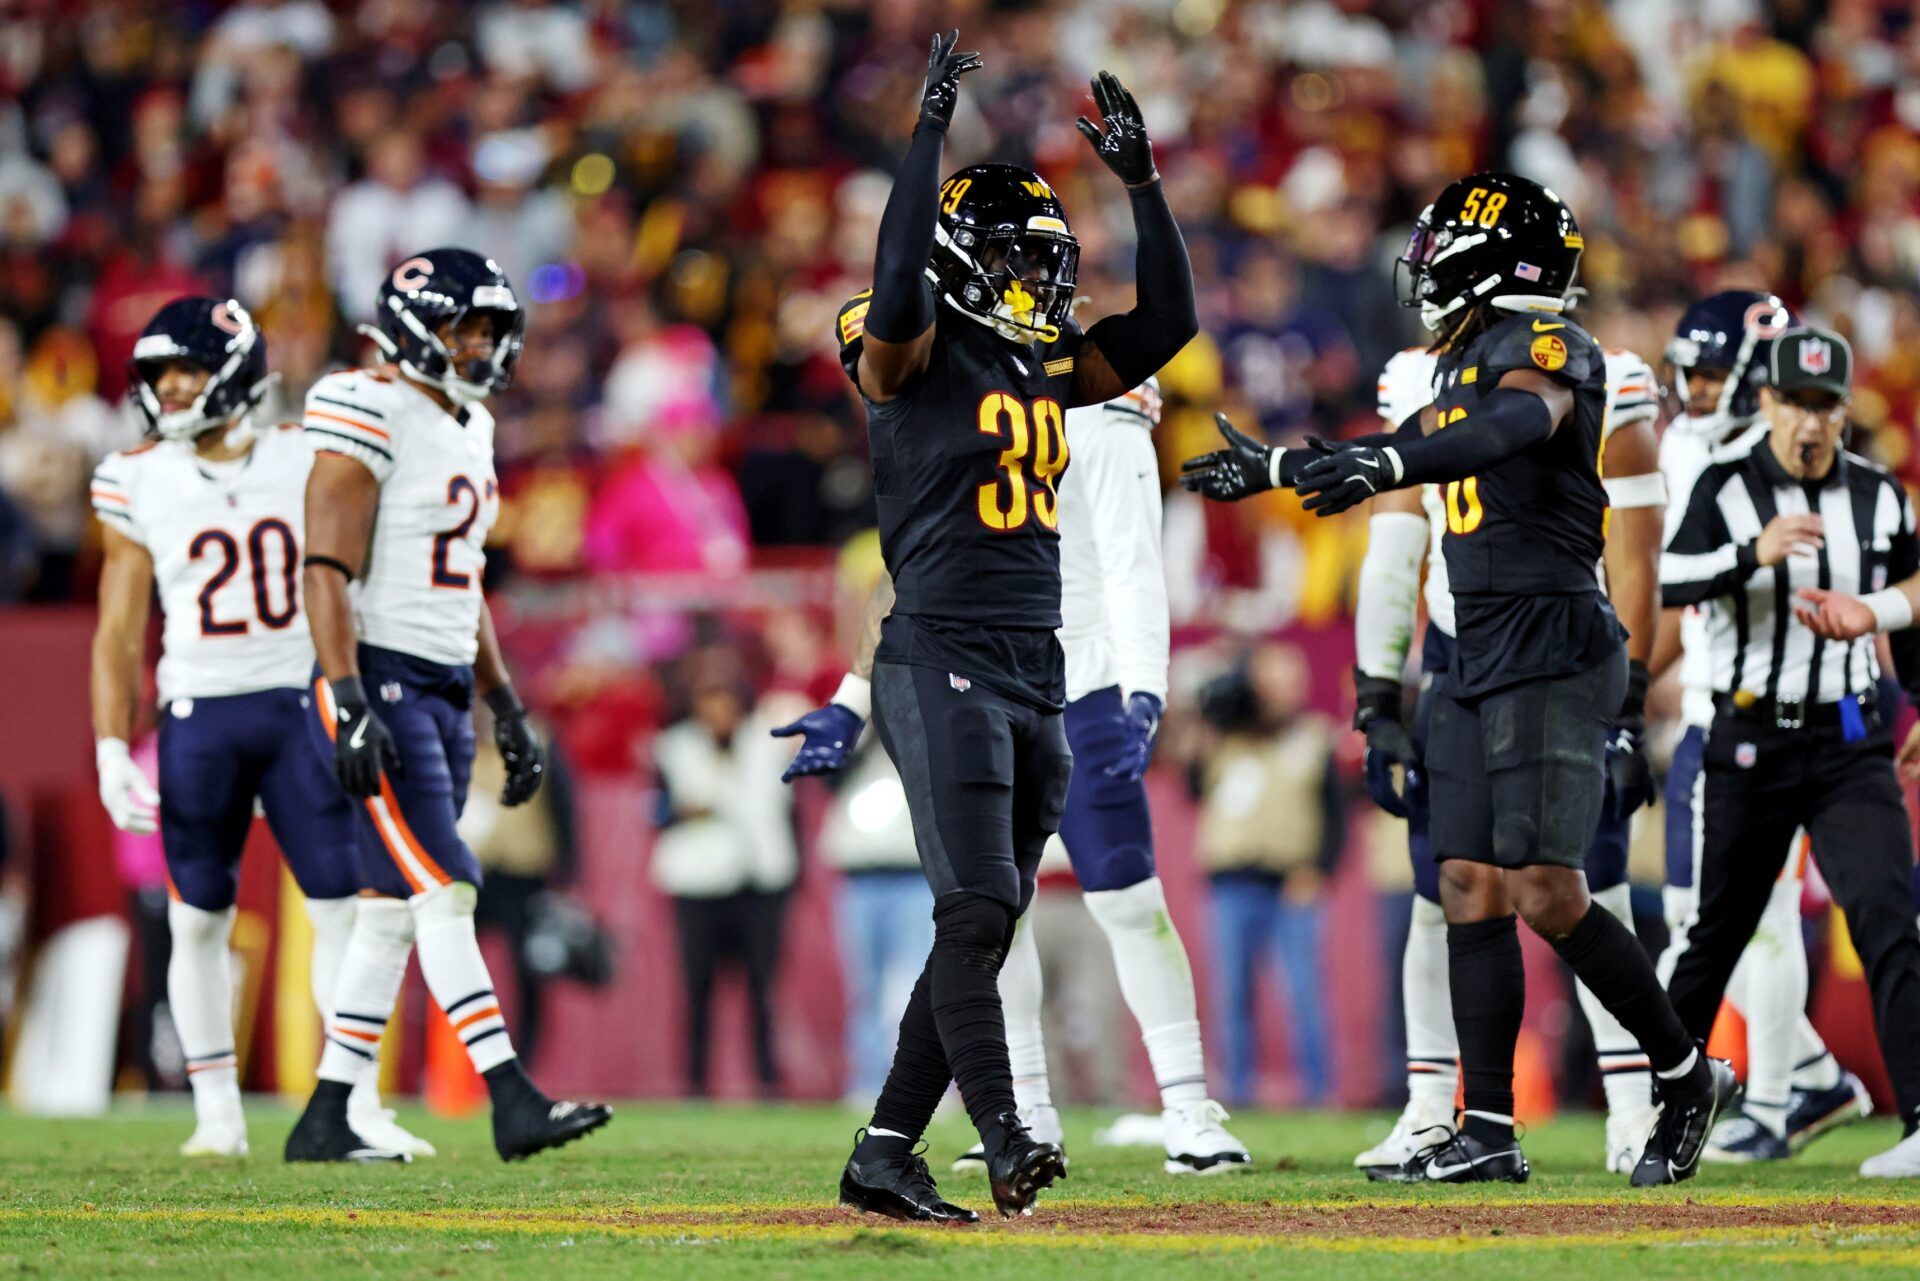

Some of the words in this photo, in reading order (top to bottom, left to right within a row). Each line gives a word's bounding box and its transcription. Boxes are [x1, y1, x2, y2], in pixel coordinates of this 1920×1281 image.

[939, 179, 972, 215] 39
[1460, 187, 1508, 228] 58
[392, 257, 435, 292] C
[977, 390, 1070, 532] 39
[431, 474, 499, 590] 2
[188, 518, 299, 636] 20
